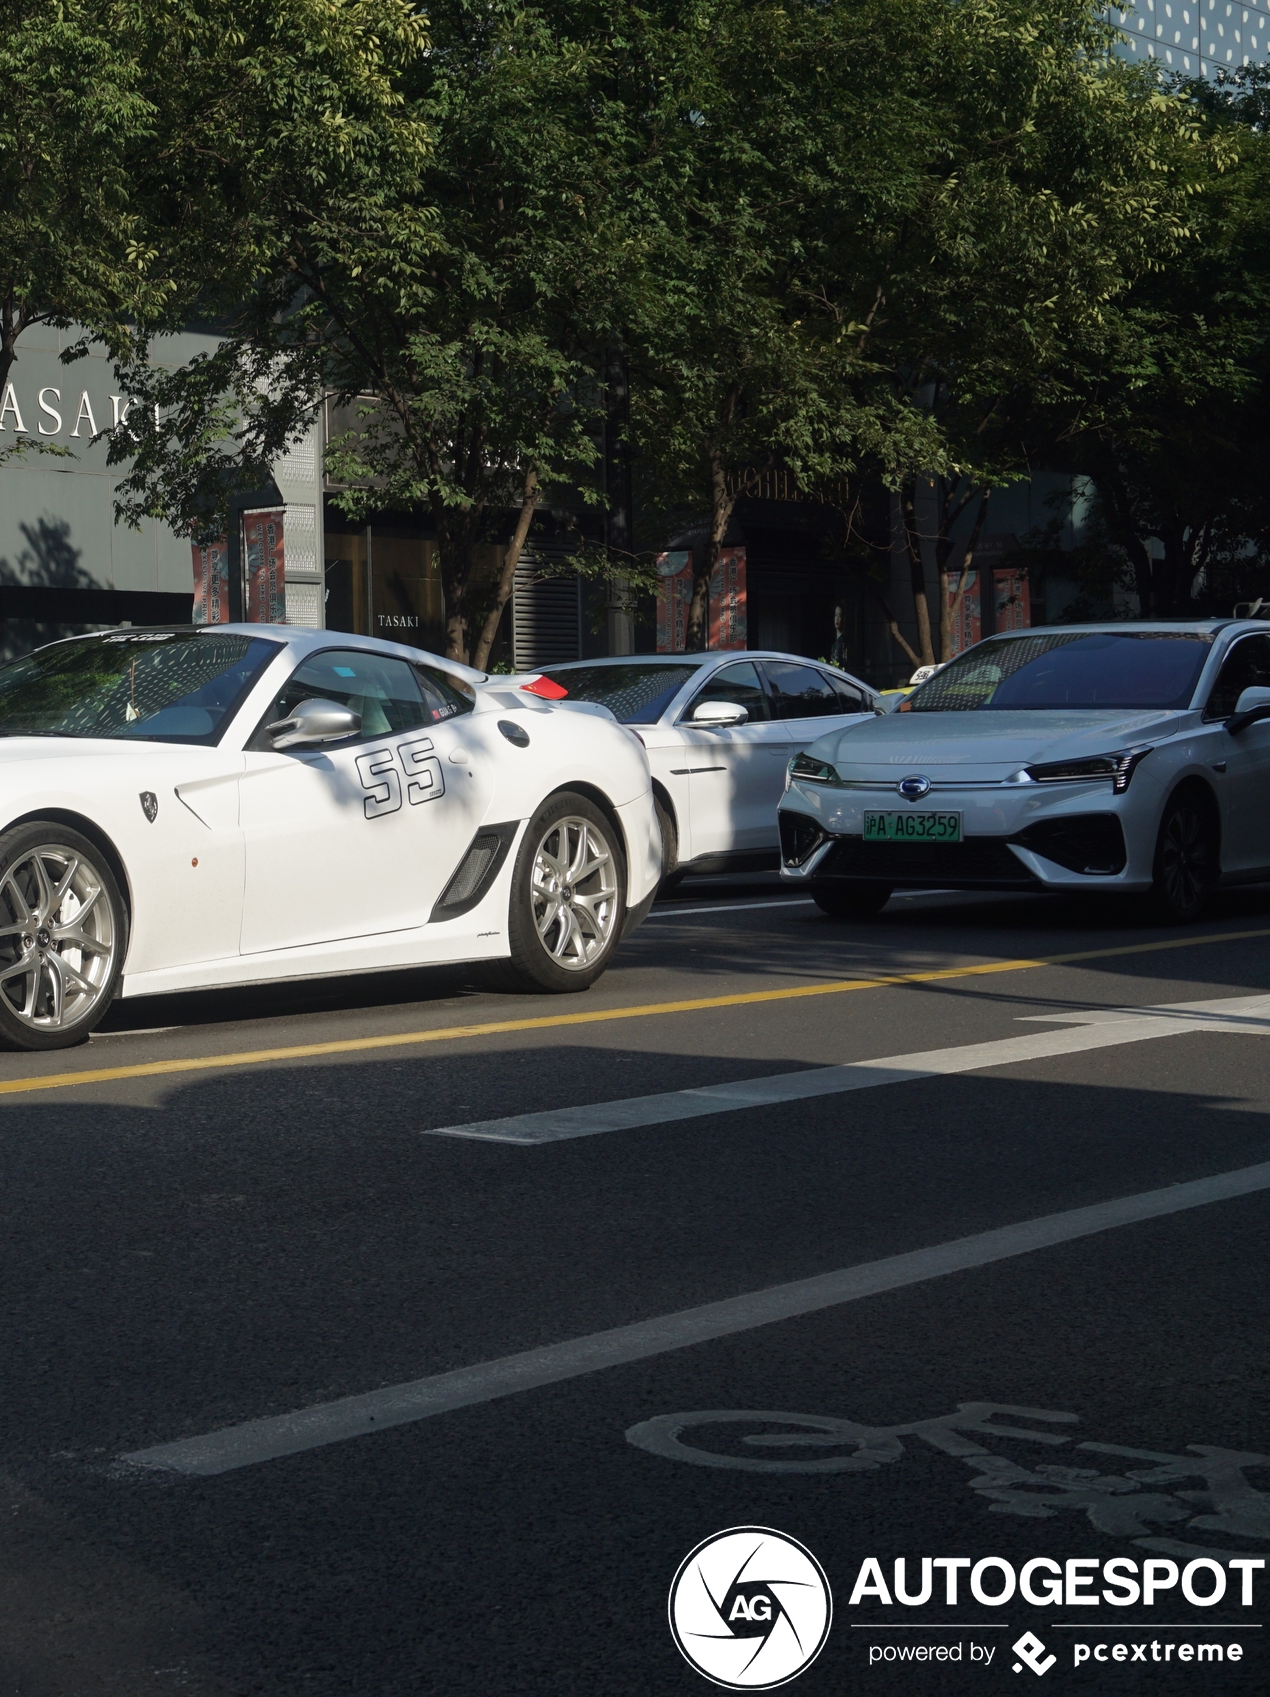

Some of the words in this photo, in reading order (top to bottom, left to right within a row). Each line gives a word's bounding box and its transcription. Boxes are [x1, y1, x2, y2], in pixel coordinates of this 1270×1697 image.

[256, 524, 264, 568] WELCOME
[259, 569, 265, 581] TO
[378, 615, 419, 627] TASAKI
[355, 737, 445, 820] 55
